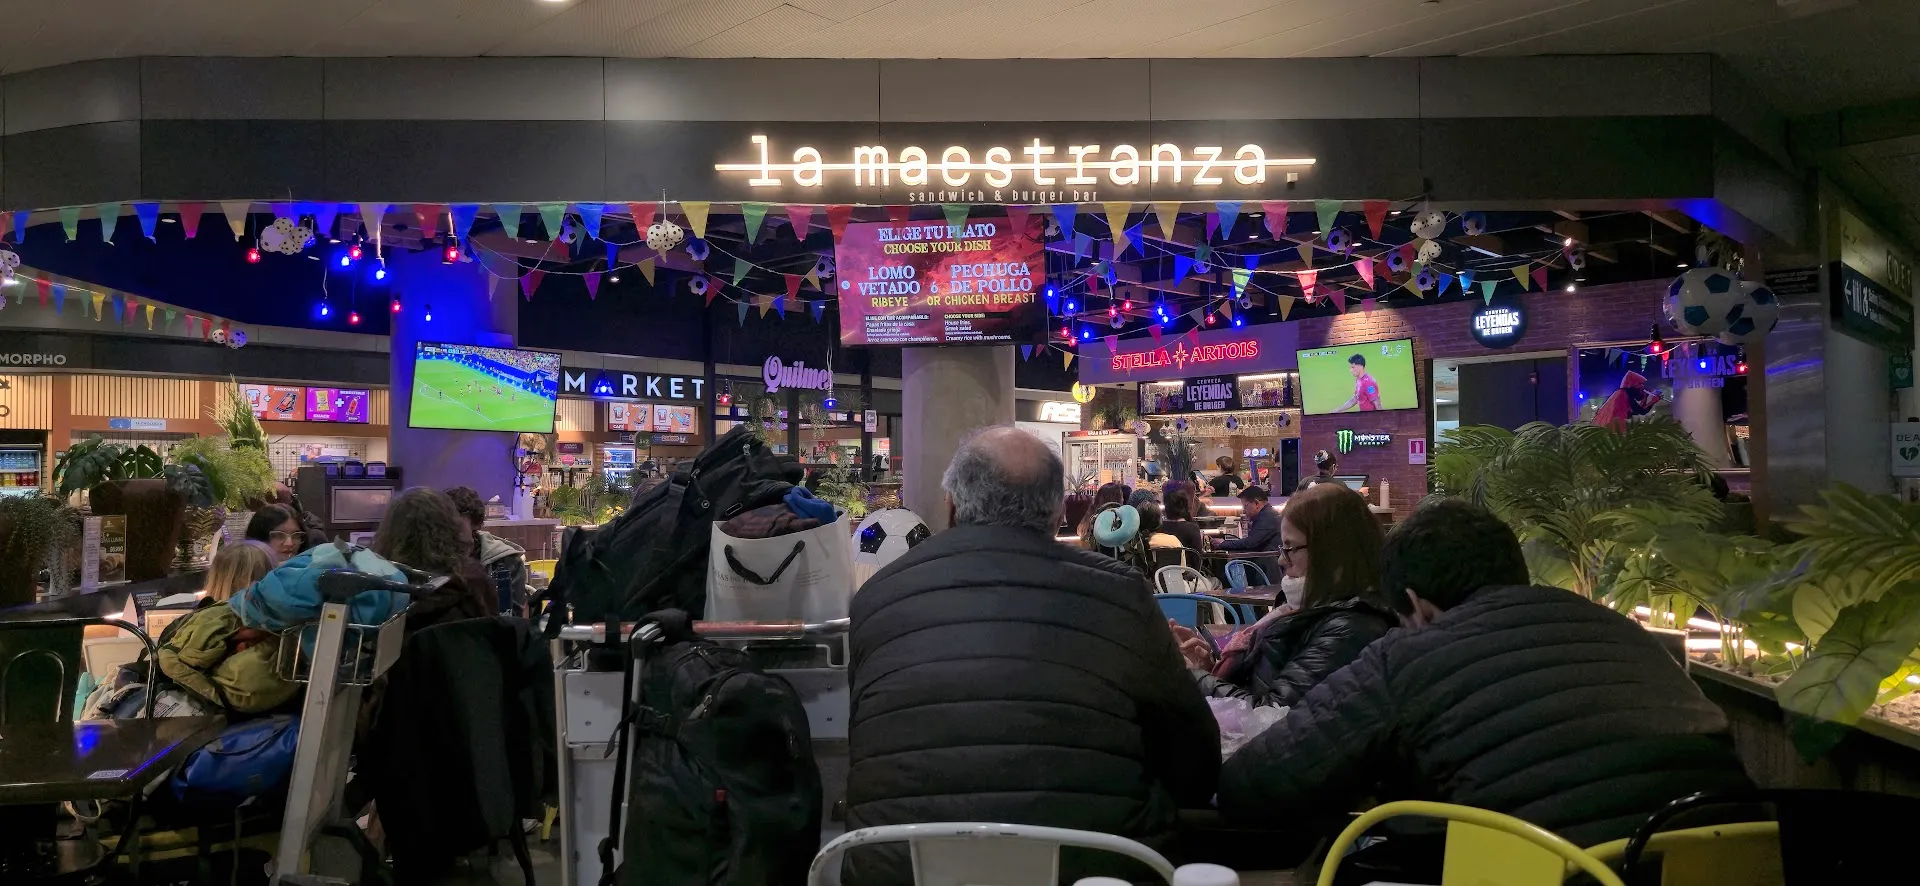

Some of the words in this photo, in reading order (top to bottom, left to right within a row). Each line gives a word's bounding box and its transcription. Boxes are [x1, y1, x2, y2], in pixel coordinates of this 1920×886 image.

[748, 134, 824, 188] la
[853, 137, 1268, 189] maestranza
[909, 190, 985, 202] sandwich
[994, 190, 1003, 202] &
[1012, 190, 1064, 204] burger
[1073, 190, 1098, 202] bar
[878, 226, 921, 242] ELIGE
[923, 225, 944, 240] TU
[946, 223, 996, 239] PLATO
[884, 242, 929, 255] CHOOSE
[930, 241, 963, 253] YOUR
[964, 240, 992, 252] DISH
[868, 266, 915, 280] LOMO
[951, 262, 1031, 278] PECHUGA
[858, 281, 921, 296] VETADO
[950, 280, 976, 294] DE
[977, 278, 1033, 293] POLLO
[871, 297, 909, 308] RIBEYE
[926, 297, 941, 307] OR
[944, 294, 990, 307] CHICKEN
[993, 292, 1037, 304] BREAST
[1475, 311, 1520, 330] LEYENDAS
[0, 353, 67, 366] MORPHO
[1112, 350, 1172, 370] STELLA
[1190, 340, 1259, 363] ARTOIS
[762, 355, 835, 394] Quilmes
[564, 369, 705, 400] MARKET
[1186, 382, 1233, 403] LEYENDAS
[1194, 403, 1203, 411] DE
[1203, 400, 1226, 411] ORIGEN
[1354, 433, 1391, 442] MONSTER
[1896, 434, 1920, 442] DEA
